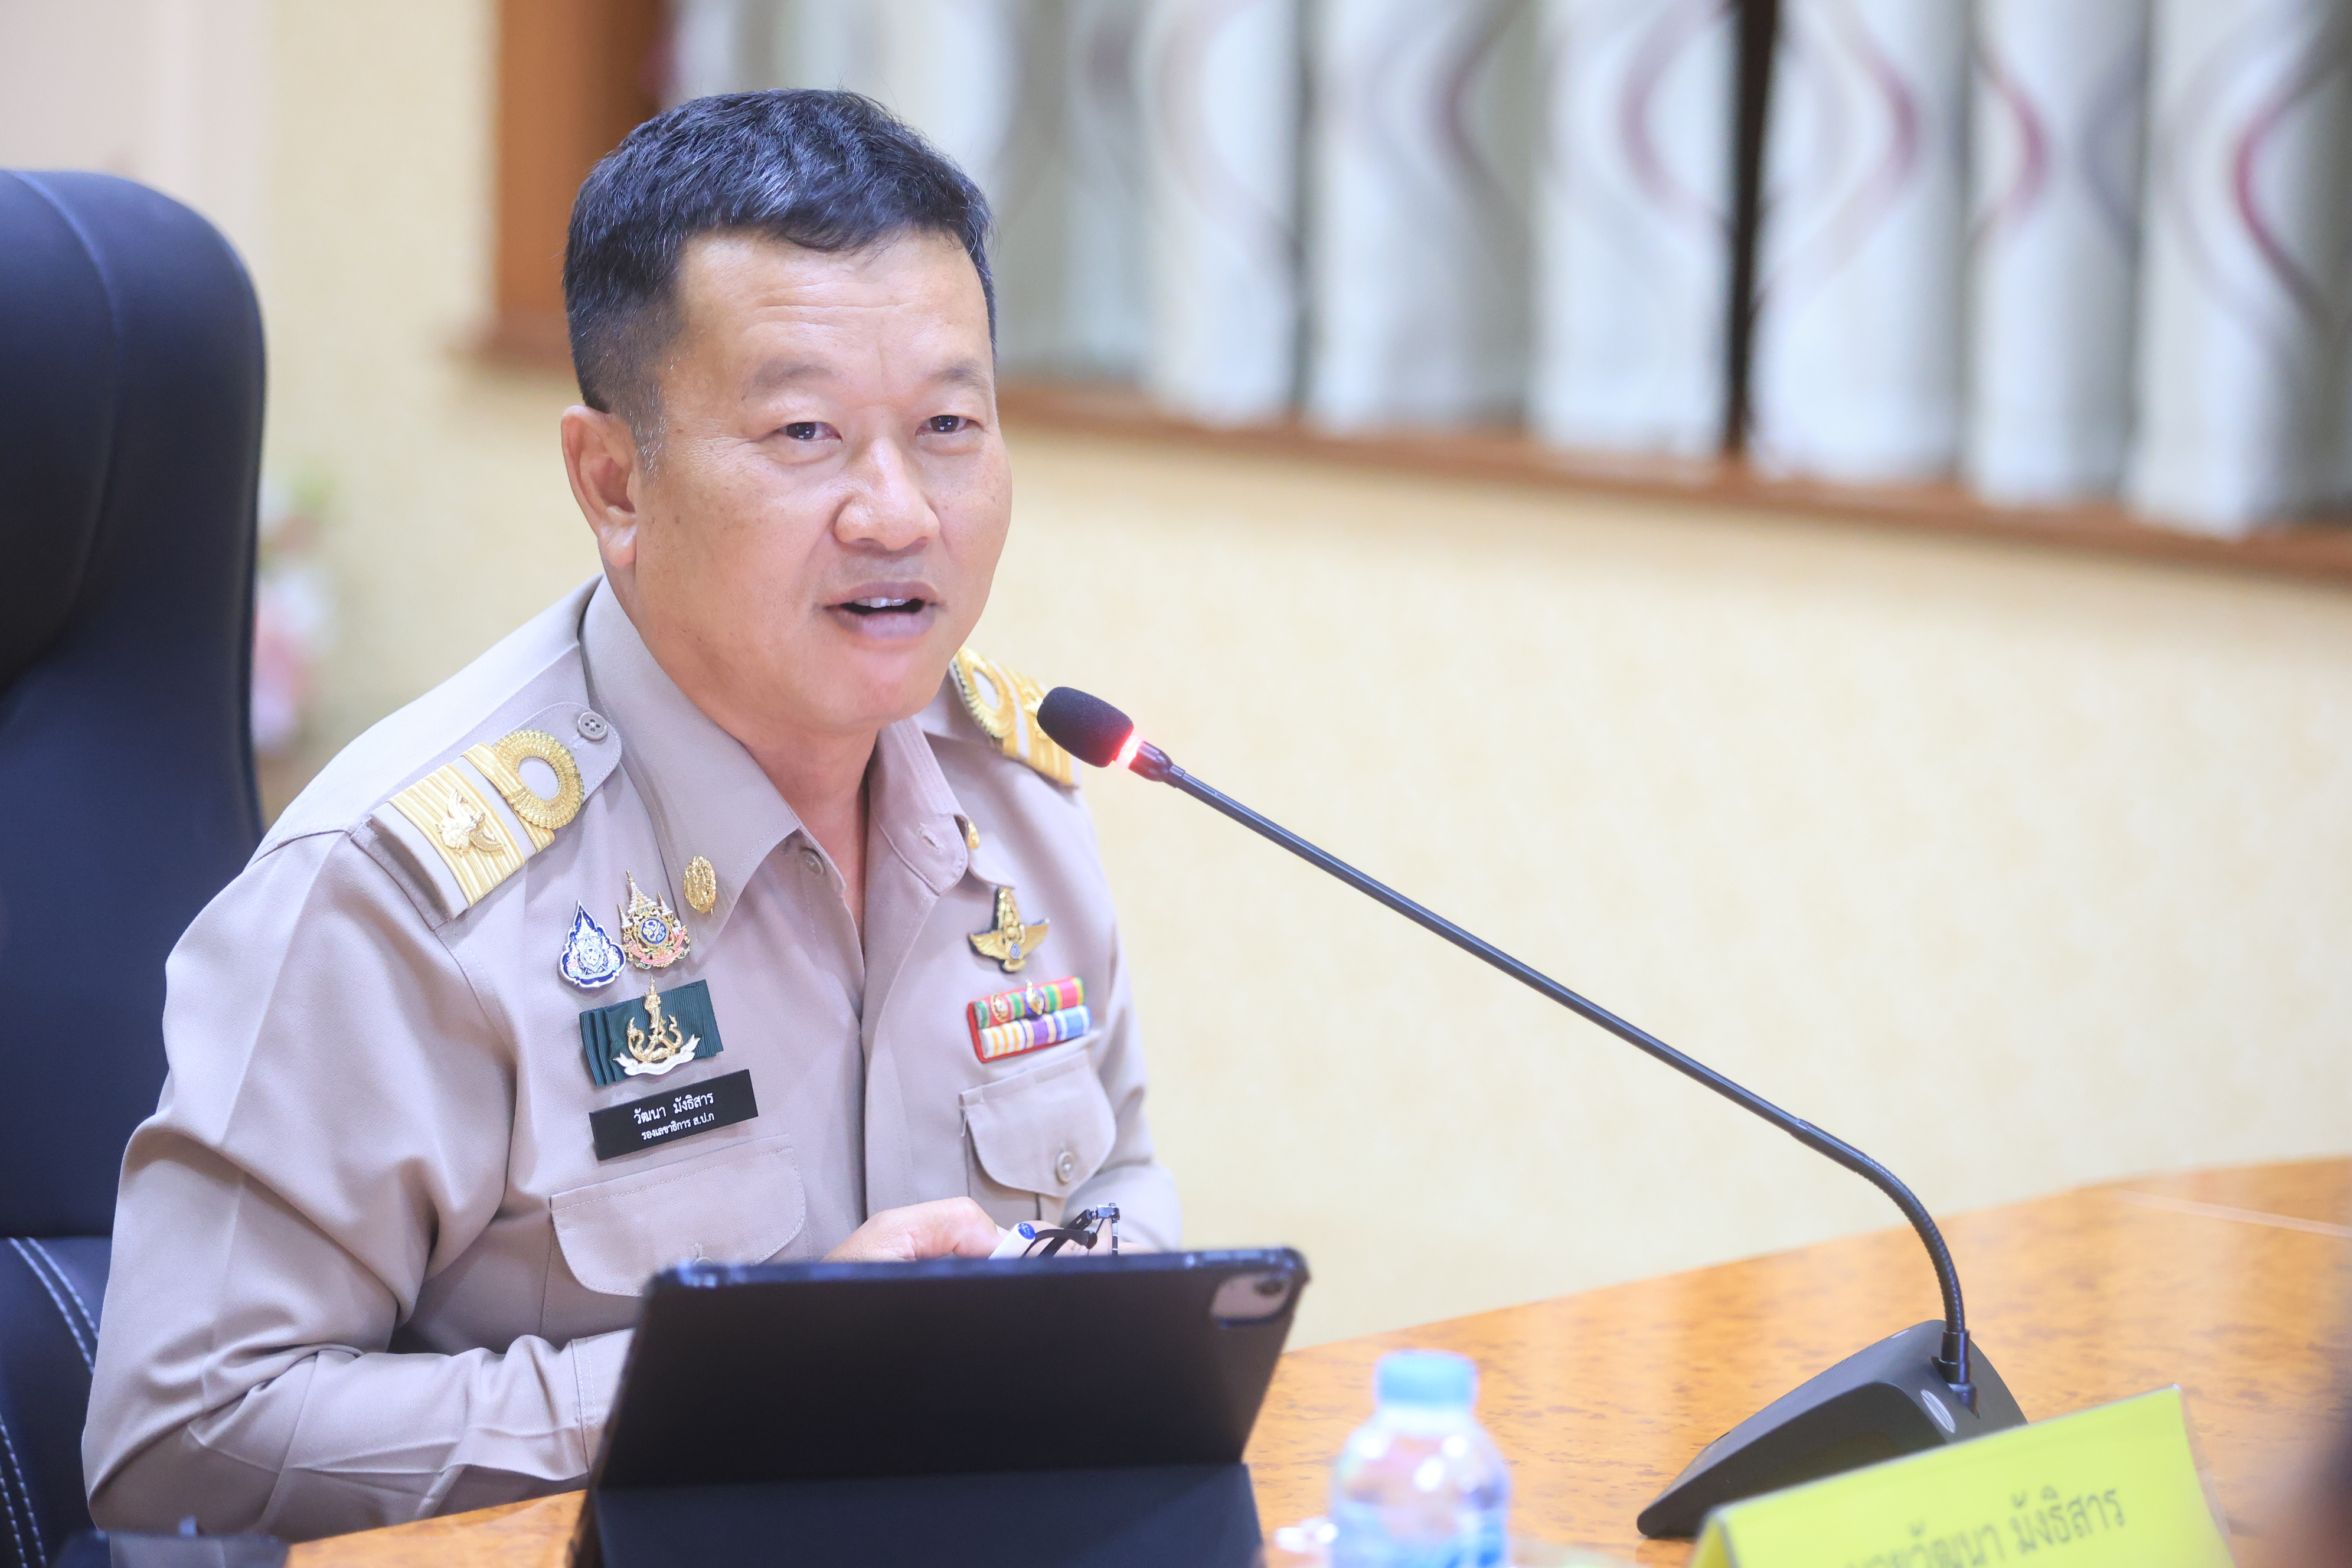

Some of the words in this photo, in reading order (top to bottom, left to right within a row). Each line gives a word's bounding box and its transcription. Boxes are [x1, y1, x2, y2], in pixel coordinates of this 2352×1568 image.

[633, 1106, 667, 1125] วัฒนา
[673, 1093, 714, 1114] มังธิสาร
[641, 1121, 691, 1140] รองเลขาธิการ
[692, 1112, 715, 1126] ส.ป.ก
